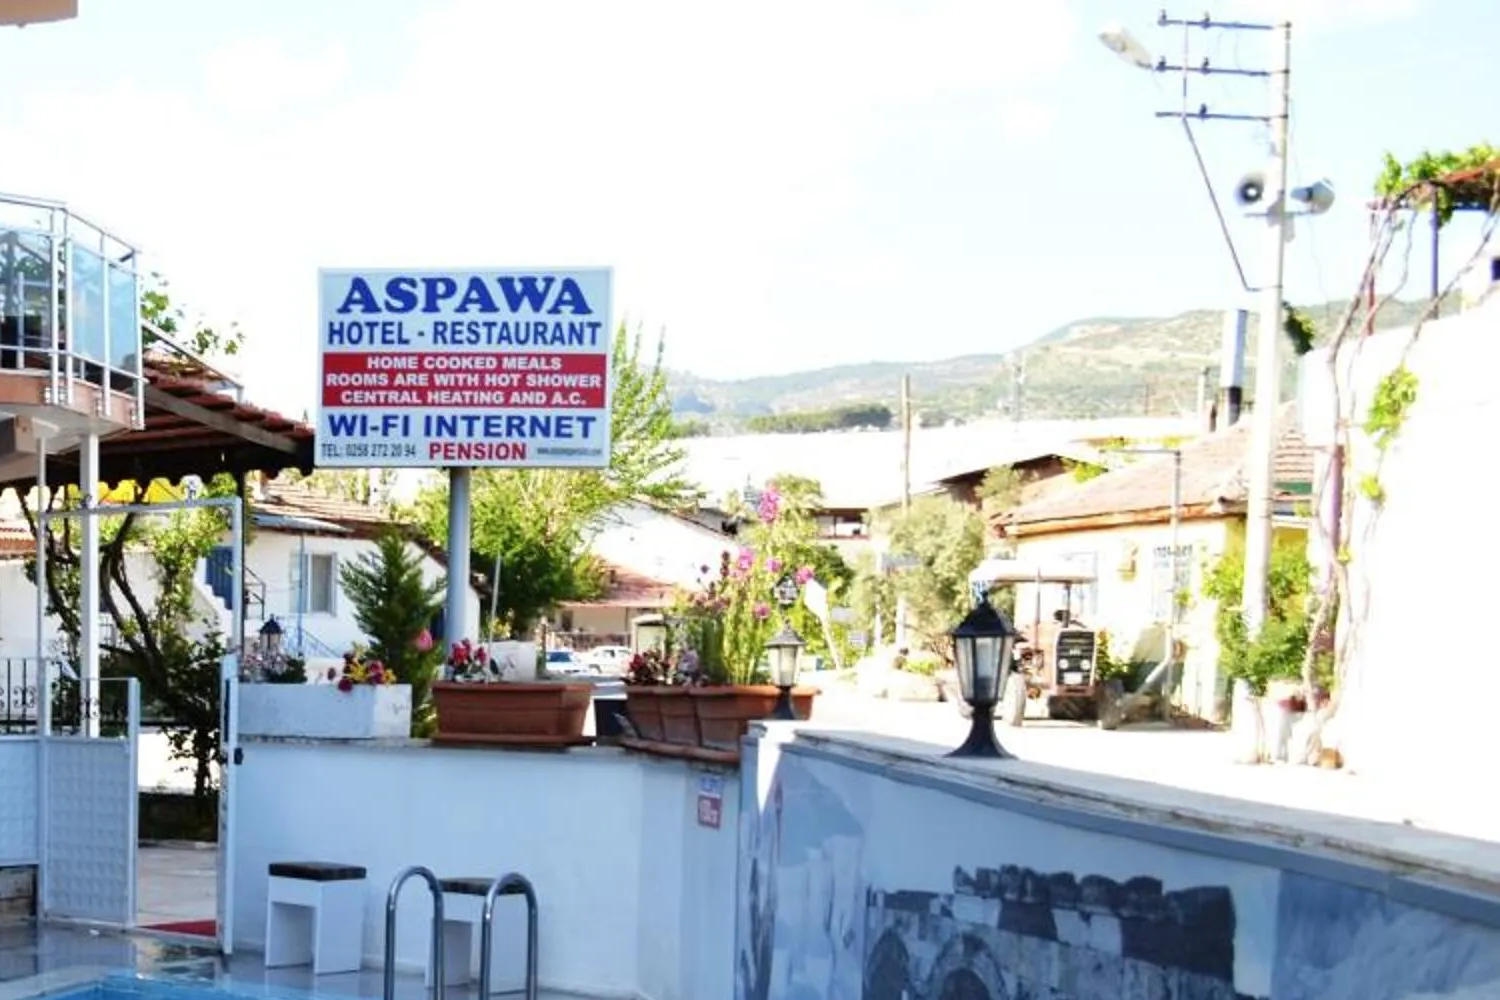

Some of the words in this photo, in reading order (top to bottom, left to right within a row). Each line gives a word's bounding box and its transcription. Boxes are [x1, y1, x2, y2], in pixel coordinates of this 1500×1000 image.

[337, 276, 593, 314] ASPAWA
[328, 321, 410, 345] HOTEL
[432, 321, 602, 346] RESTAURANT
[367, 356, 418, 369] HOME
[423, 356, 498, 369] COOKED
[501, 357, 562, 370] MEALS
[326, 373, 388, 386] ROOMS
[393, 373, 428, 386] ARE
[433, 373, 479, 386] WITH
[484, 374, 522, 386] HOT
[525, 373, 601, 388] SHOWER
[341, 390, 422, 404] CENTRAL
[427, 390, 505, 405] HEATING
[509, 391, 547, 405] AND
[551, 391, 587, 405] A.C.
[328, 414, 410, 437] WI-FI
[423, 415, 596, 438] INTERNET
[429, 442, 526, 460] PENSION
